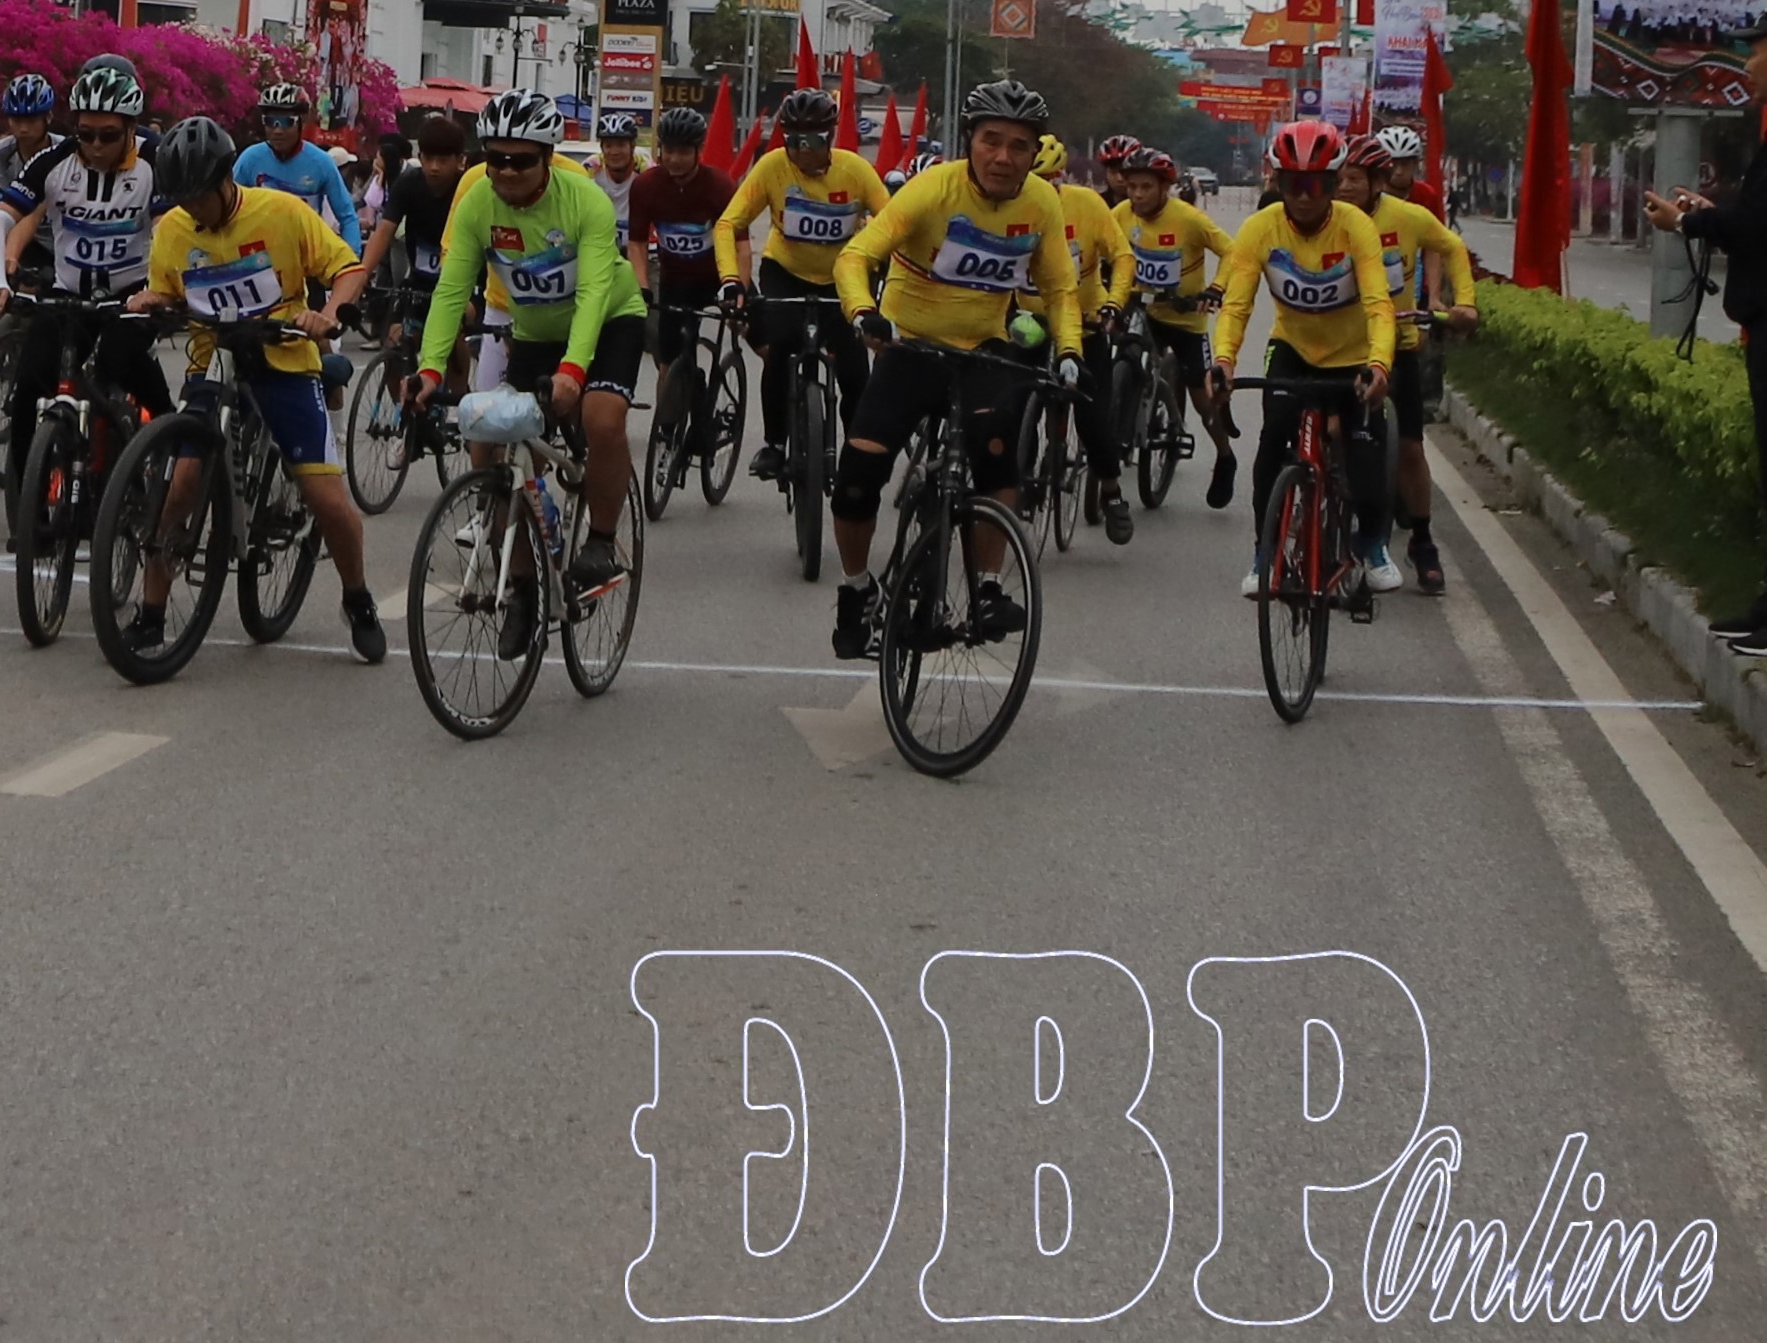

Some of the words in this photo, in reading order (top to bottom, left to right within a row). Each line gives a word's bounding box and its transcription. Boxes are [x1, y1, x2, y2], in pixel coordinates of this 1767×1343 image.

[604, 57, 641, 68] Jollibee
[70, 205, 143, 222] GIANT
[798, 216, 843, 237] 008
[76, 238, 127, 262] 015
[666, 236, 703, 251] 025
[955, 253, 1016, 282] 005
[207, 279, 262, 312] 011
[1283, 279, 1339, 304] 002
